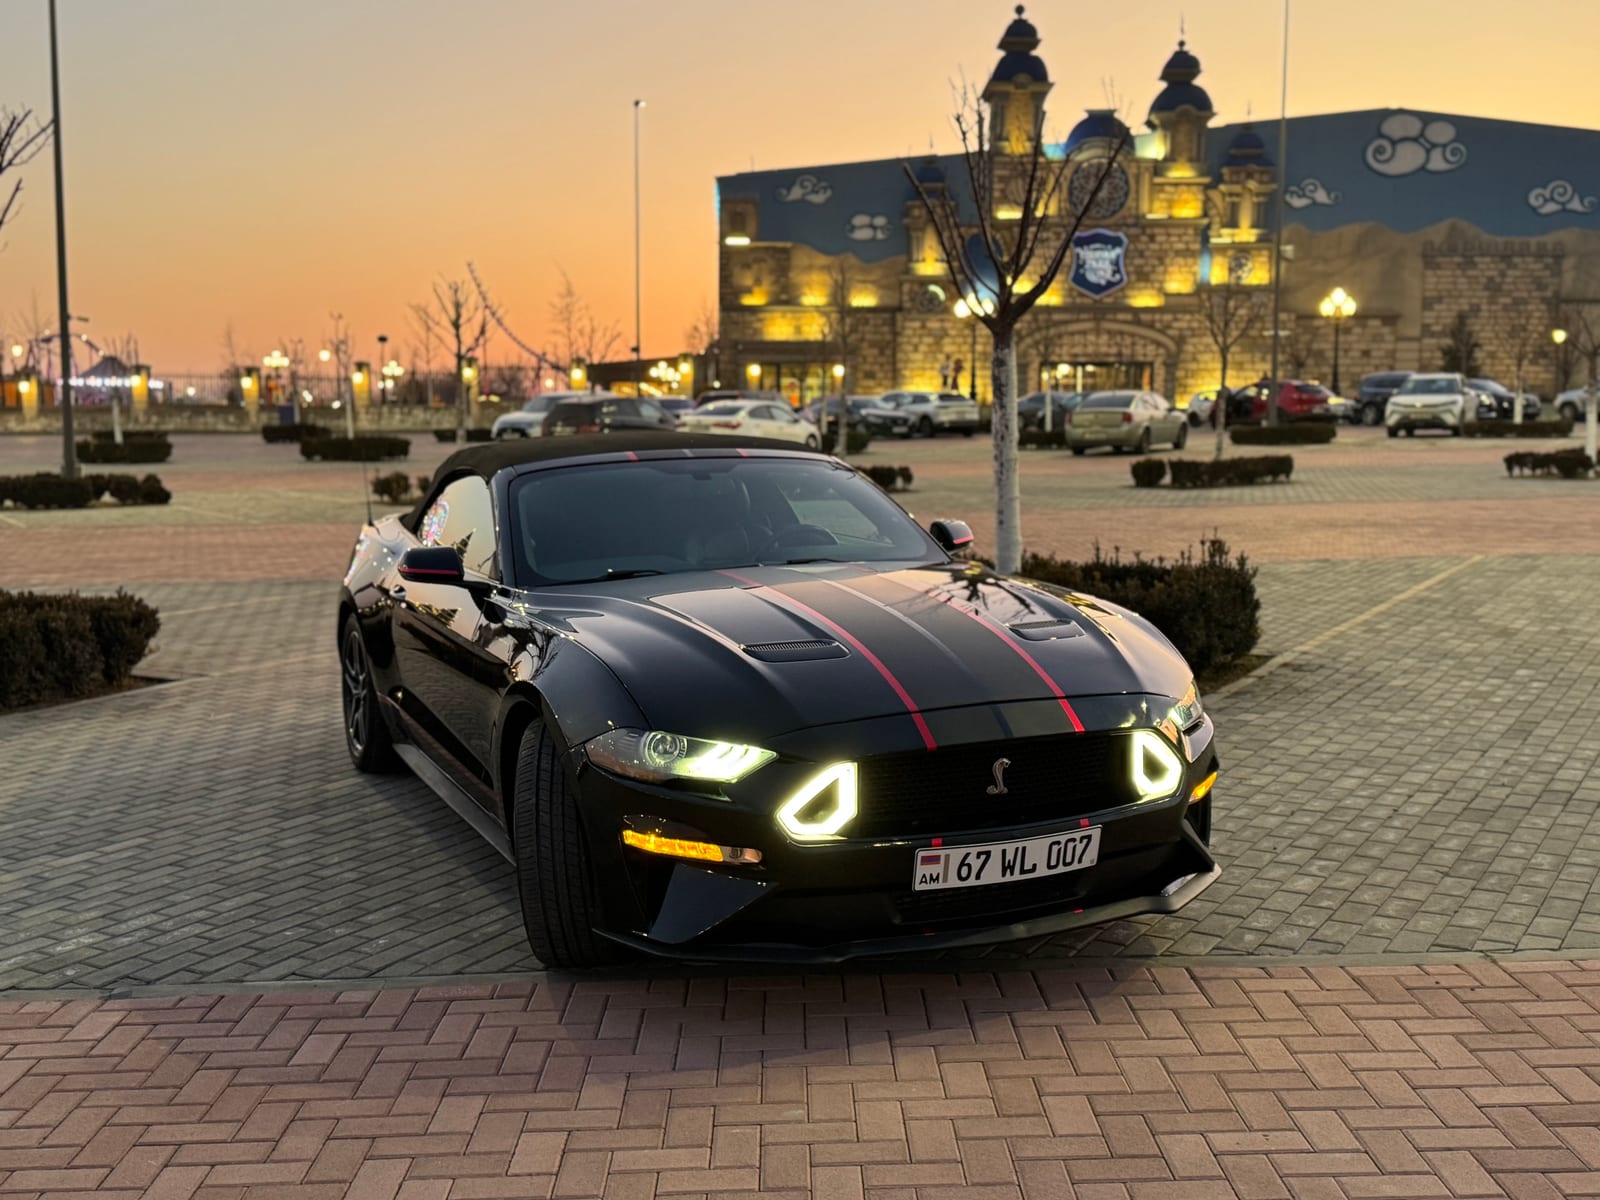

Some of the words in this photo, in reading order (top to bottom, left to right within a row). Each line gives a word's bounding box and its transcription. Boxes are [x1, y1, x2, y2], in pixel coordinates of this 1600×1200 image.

[957, 850, 992, 882] 67
[1001, 846, 1037, 878] WL
[1046, 834, 1093, 870] 007
[919, 873, 940, 885] AM
